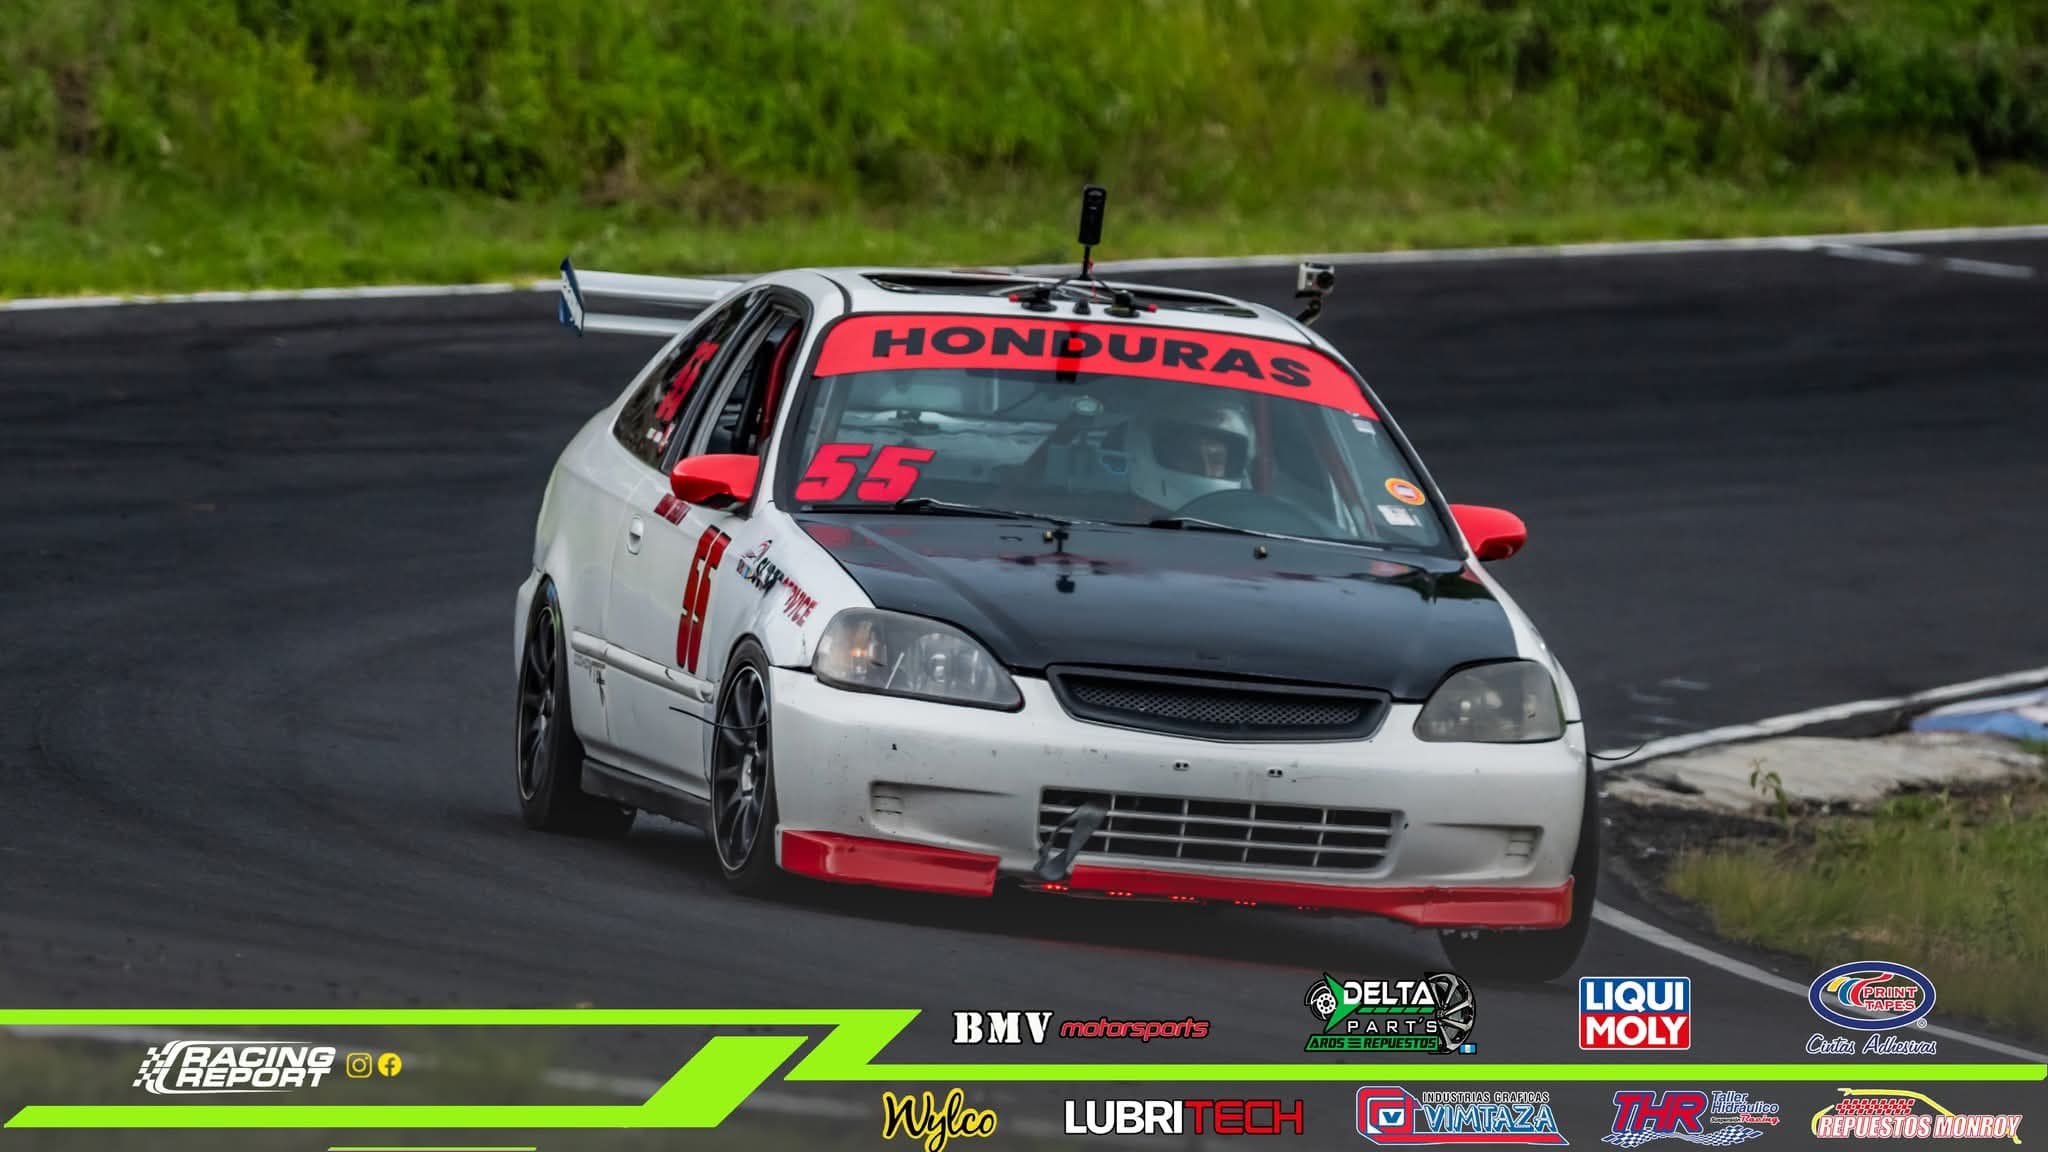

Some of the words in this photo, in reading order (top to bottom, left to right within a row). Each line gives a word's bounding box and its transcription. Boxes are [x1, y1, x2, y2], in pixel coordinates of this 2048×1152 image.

[872, 327, 1312, 387] HONDURAS
[795, 443, 936, 502] 55
[675, 524, 732, 675] 55
